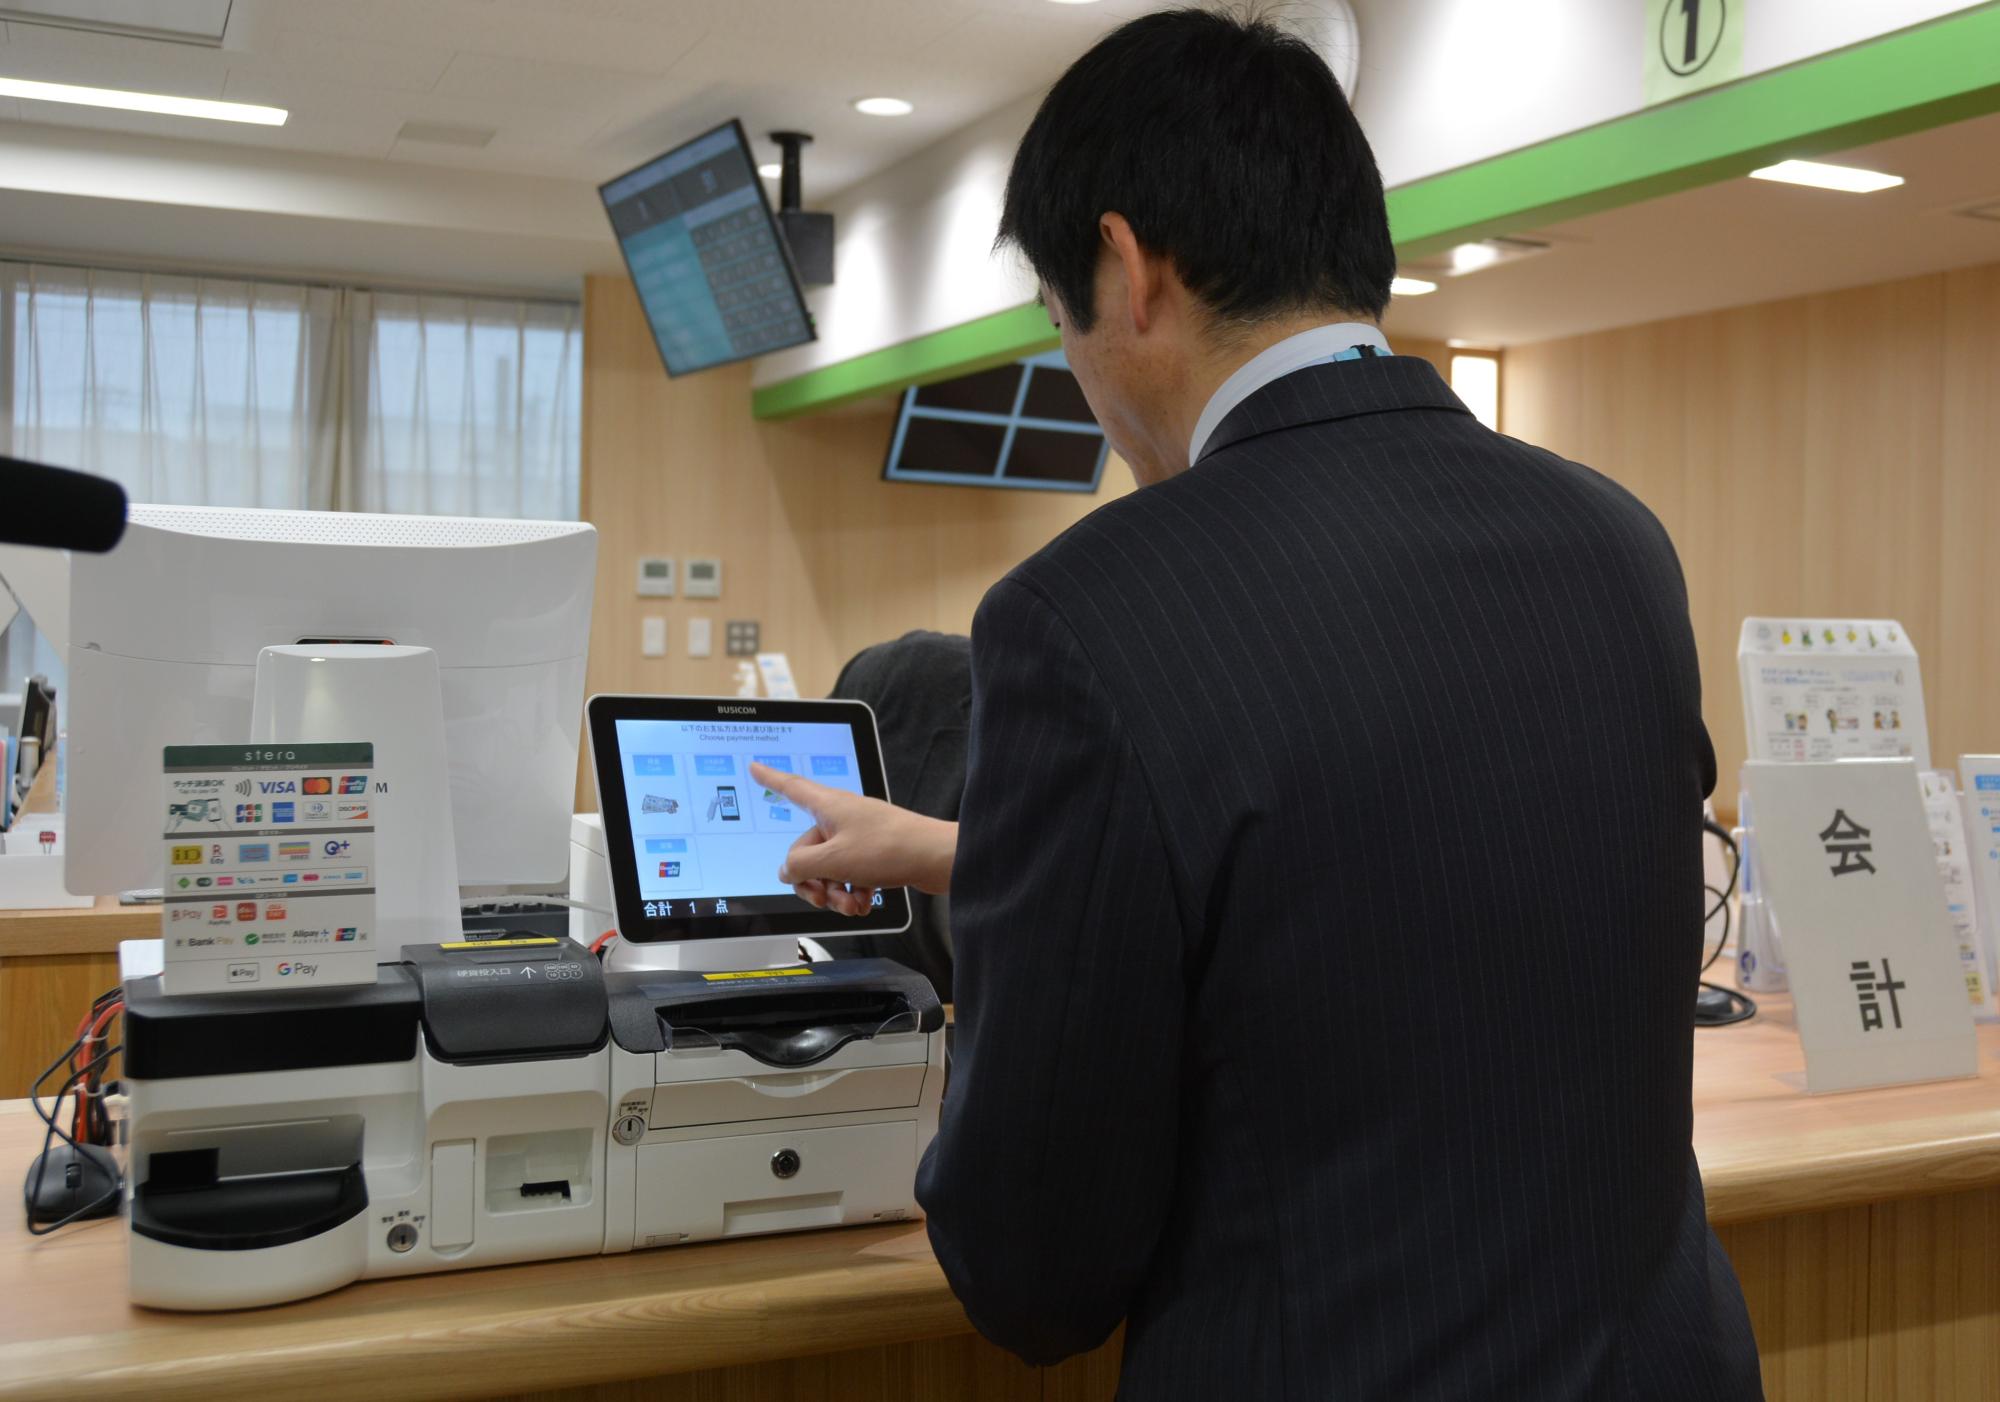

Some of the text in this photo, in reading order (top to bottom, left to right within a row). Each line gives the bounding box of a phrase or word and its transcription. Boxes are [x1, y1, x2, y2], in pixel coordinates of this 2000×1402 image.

[717, 705, 757, 715] BUSICOM
[700, 734, 725, 742] Choose
[726, 735, 754, 743] payment
[245, 750, 296, 761] stera
[257, 781, 296, 794] VISA
[375, 782, 388, 794] M
[643, 901, 673, 917] 合計
[689, 902, 696, 914] 1
[715, 899, 729, 914] 点
[1819, 808, 1906, 1032] 会計
[188, 936, 215, 947] Bank
[239, 968, 256, 977] Pay
[277, 962, 318, 977] G Pay
